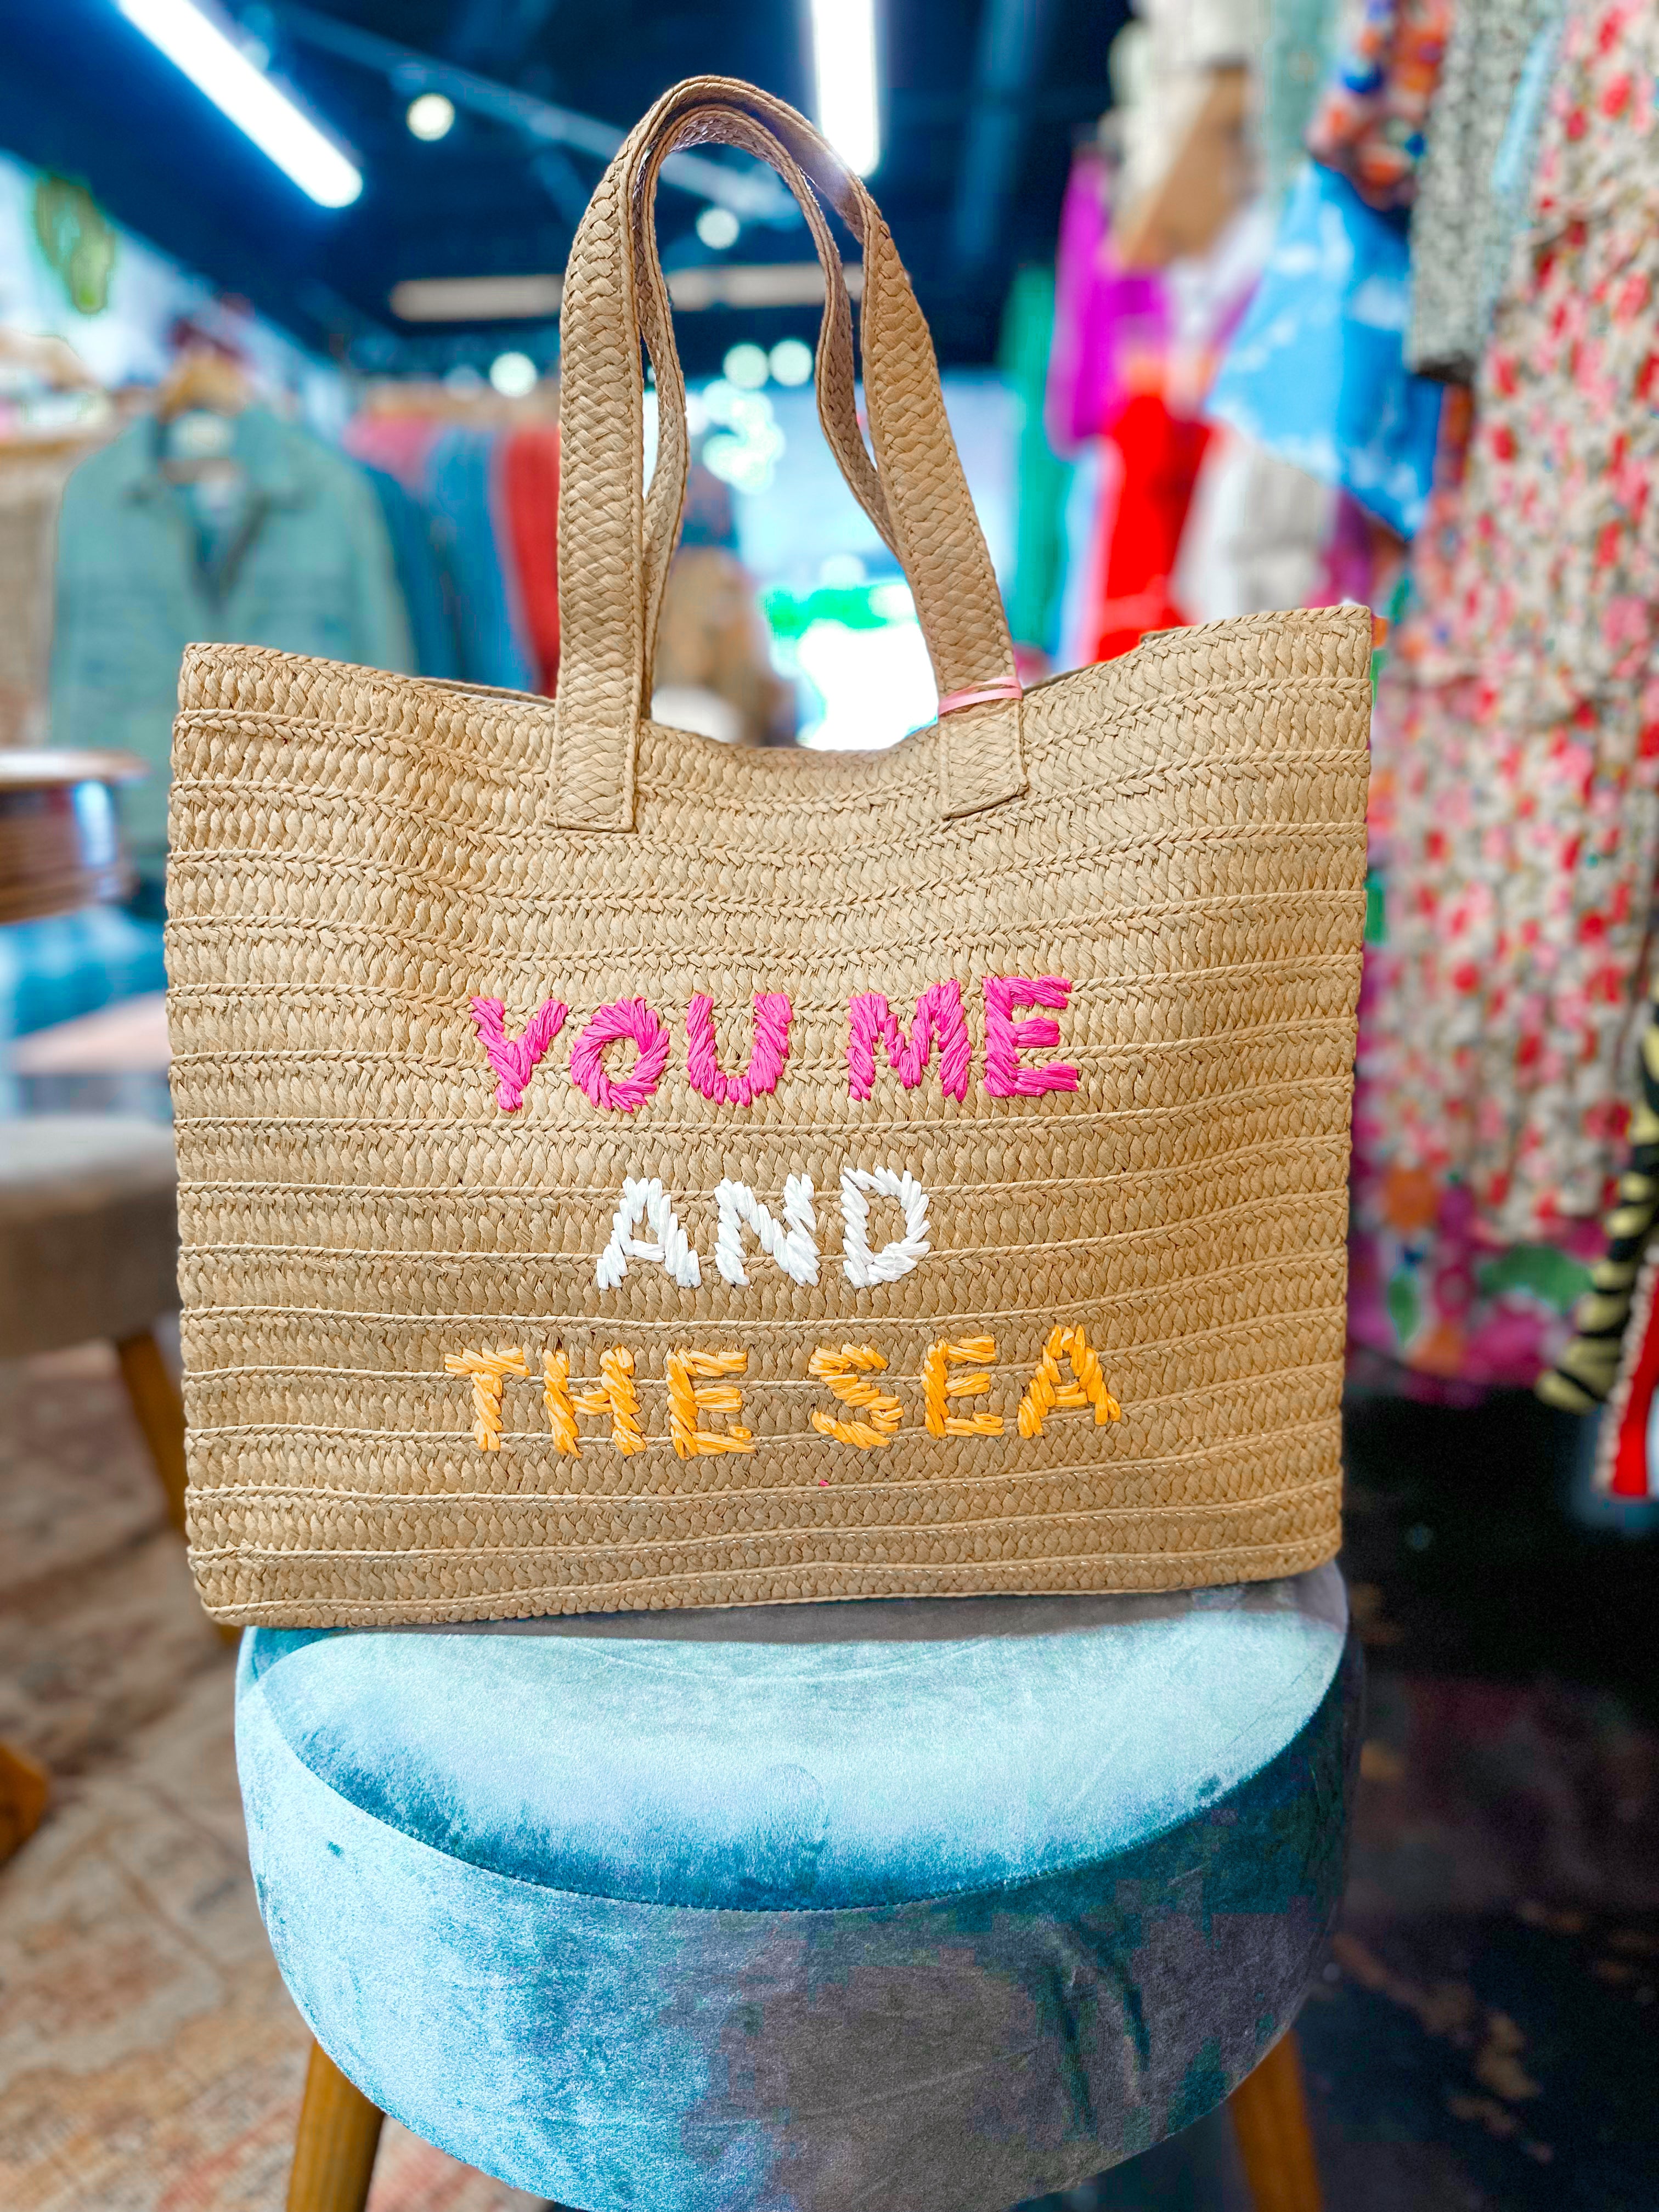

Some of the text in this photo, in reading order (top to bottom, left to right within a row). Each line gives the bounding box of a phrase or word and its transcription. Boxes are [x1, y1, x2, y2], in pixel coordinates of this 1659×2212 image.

[470, 975, 1080, 1113] YOU ME
[596, 1165, 931, 1290] AND
[444, 1324, 1121, 1459] THE SEA
